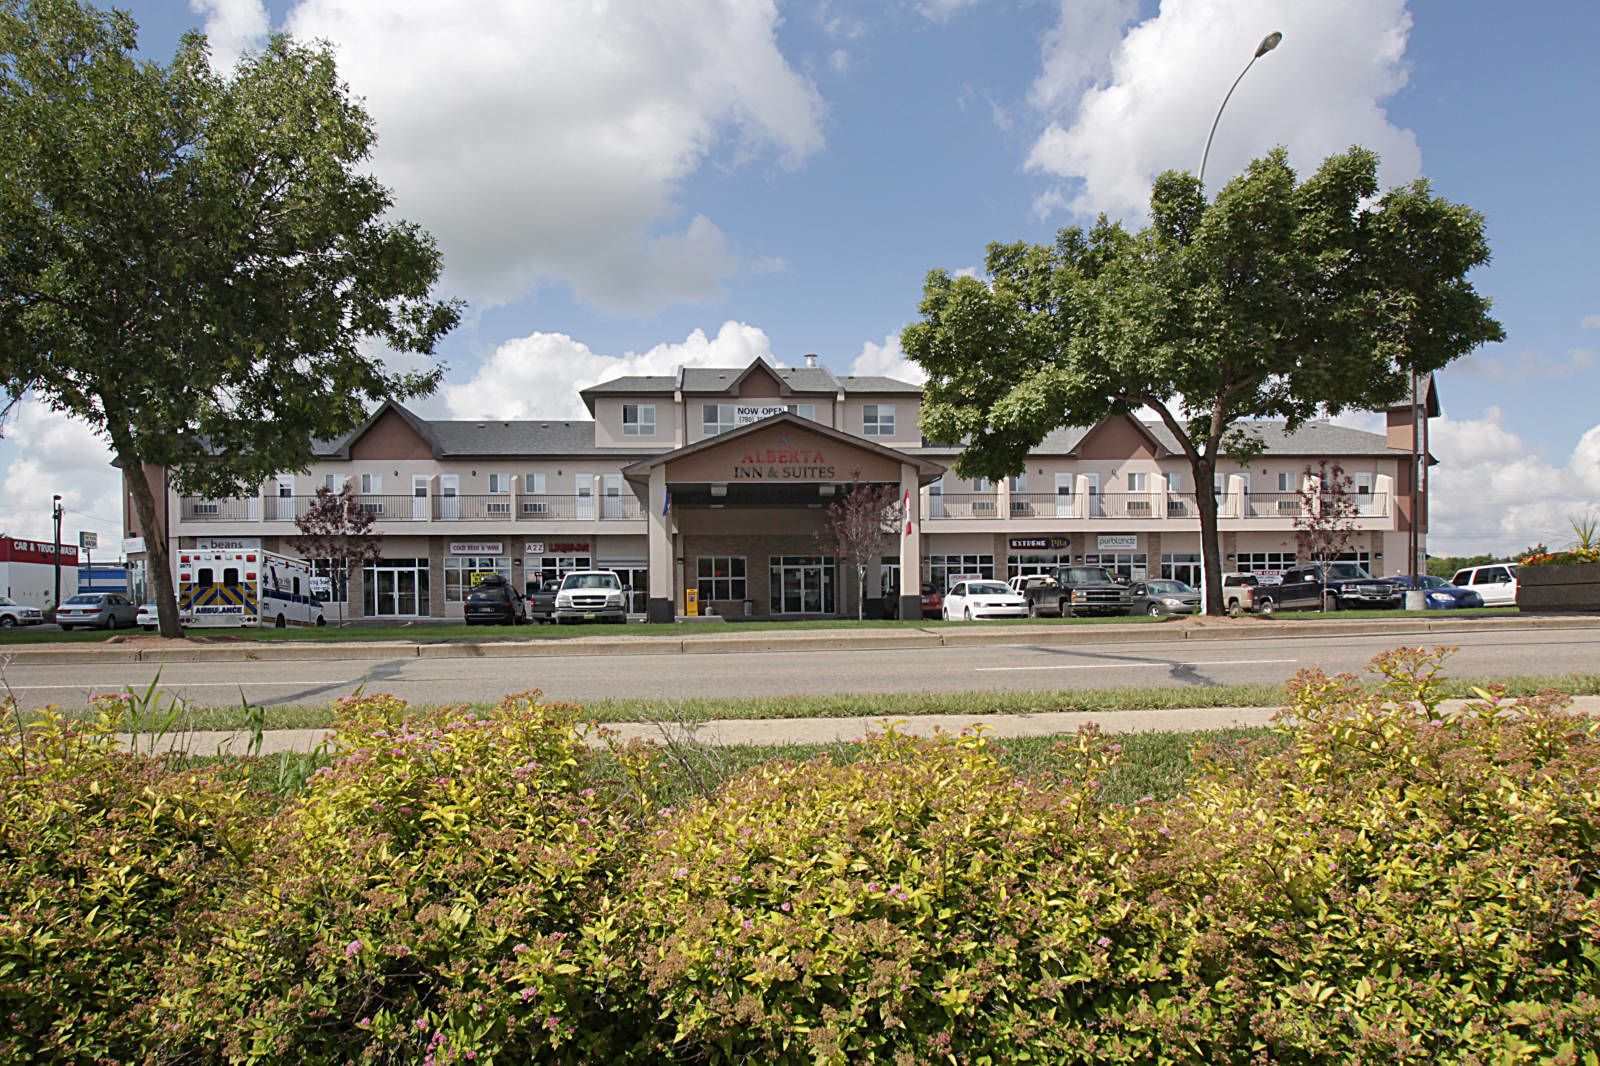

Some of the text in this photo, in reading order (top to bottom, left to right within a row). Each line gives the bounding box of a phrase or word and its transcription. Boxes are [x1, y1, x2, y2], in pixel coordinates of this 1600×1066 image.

[737, 407, 785, 416] NOW OPEN
[742, 448, 825, 464] ALBERTA
[734, 466, 835, 478] INN & SUITES
[14, 541, 28, 552] CAR
[37, 543, 57, 554] TRUC
[210, 539, 243, 549] beans
[195, 606, 242, 614] AMBULANCE
